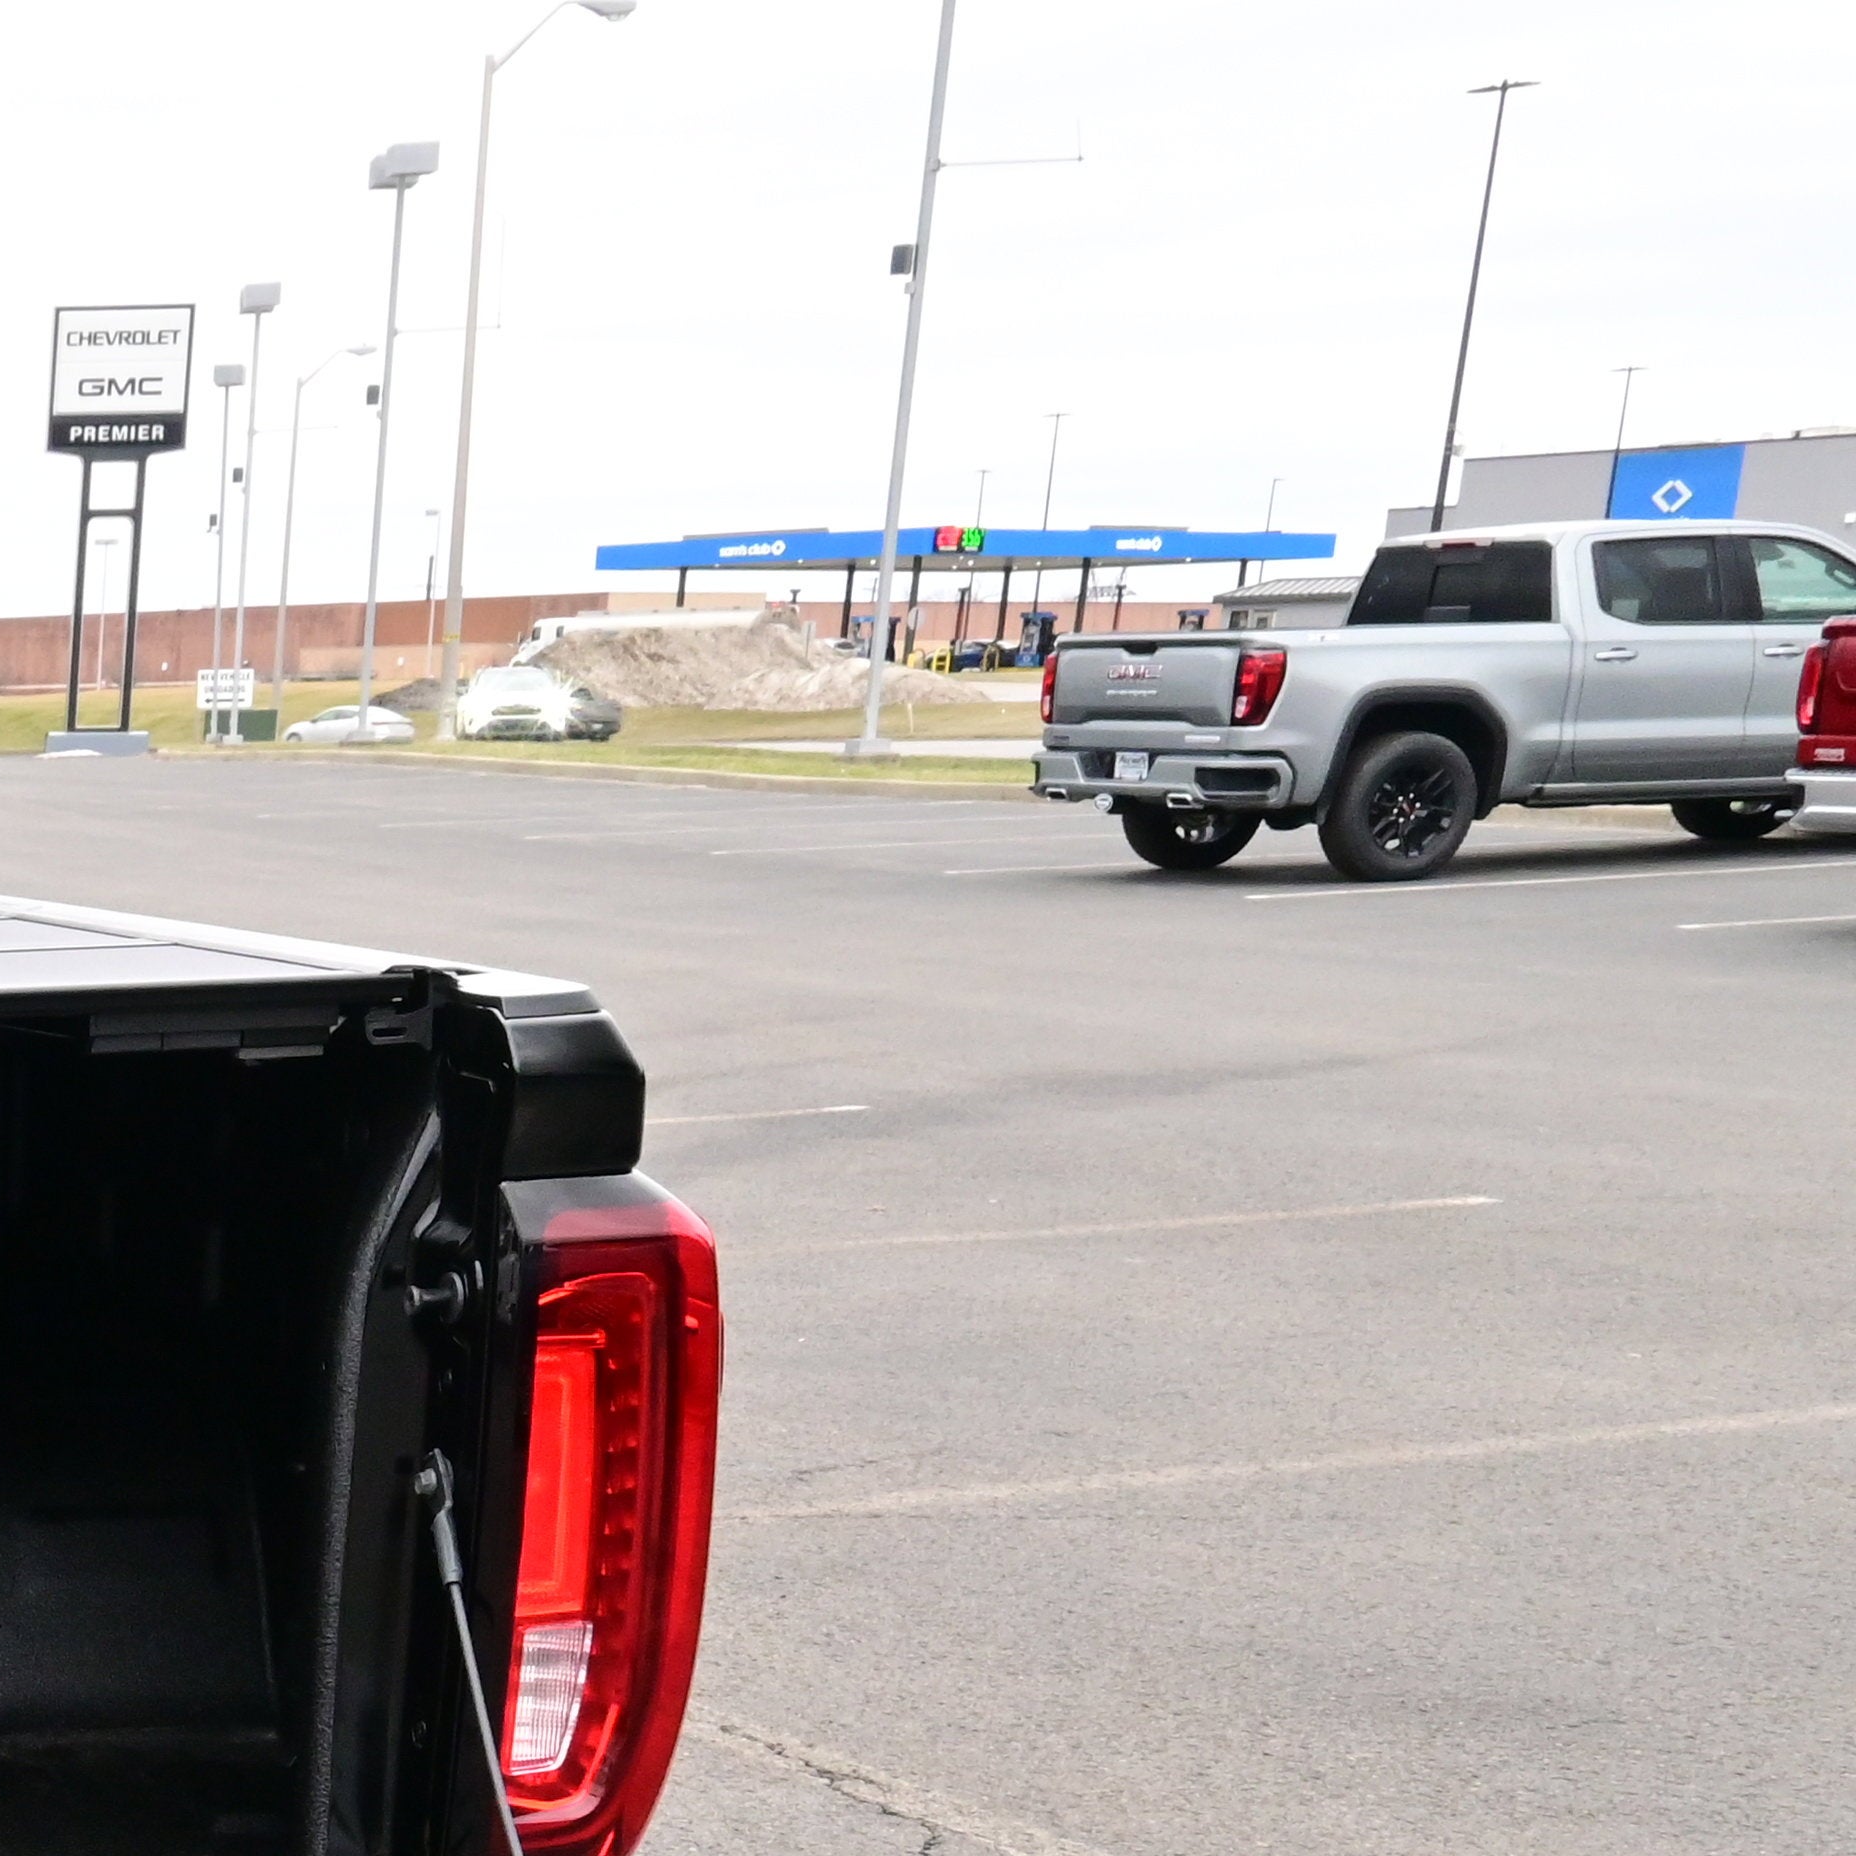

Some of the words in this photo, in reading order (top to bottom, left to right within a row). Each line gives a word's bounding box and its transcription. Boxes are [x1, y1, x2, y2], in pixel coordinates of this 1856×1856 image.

[66, 329, 181, 347] CHEVROLET
[78, 376, 163, 397] GMC
[69, 423, 165, 442] PREMIER
